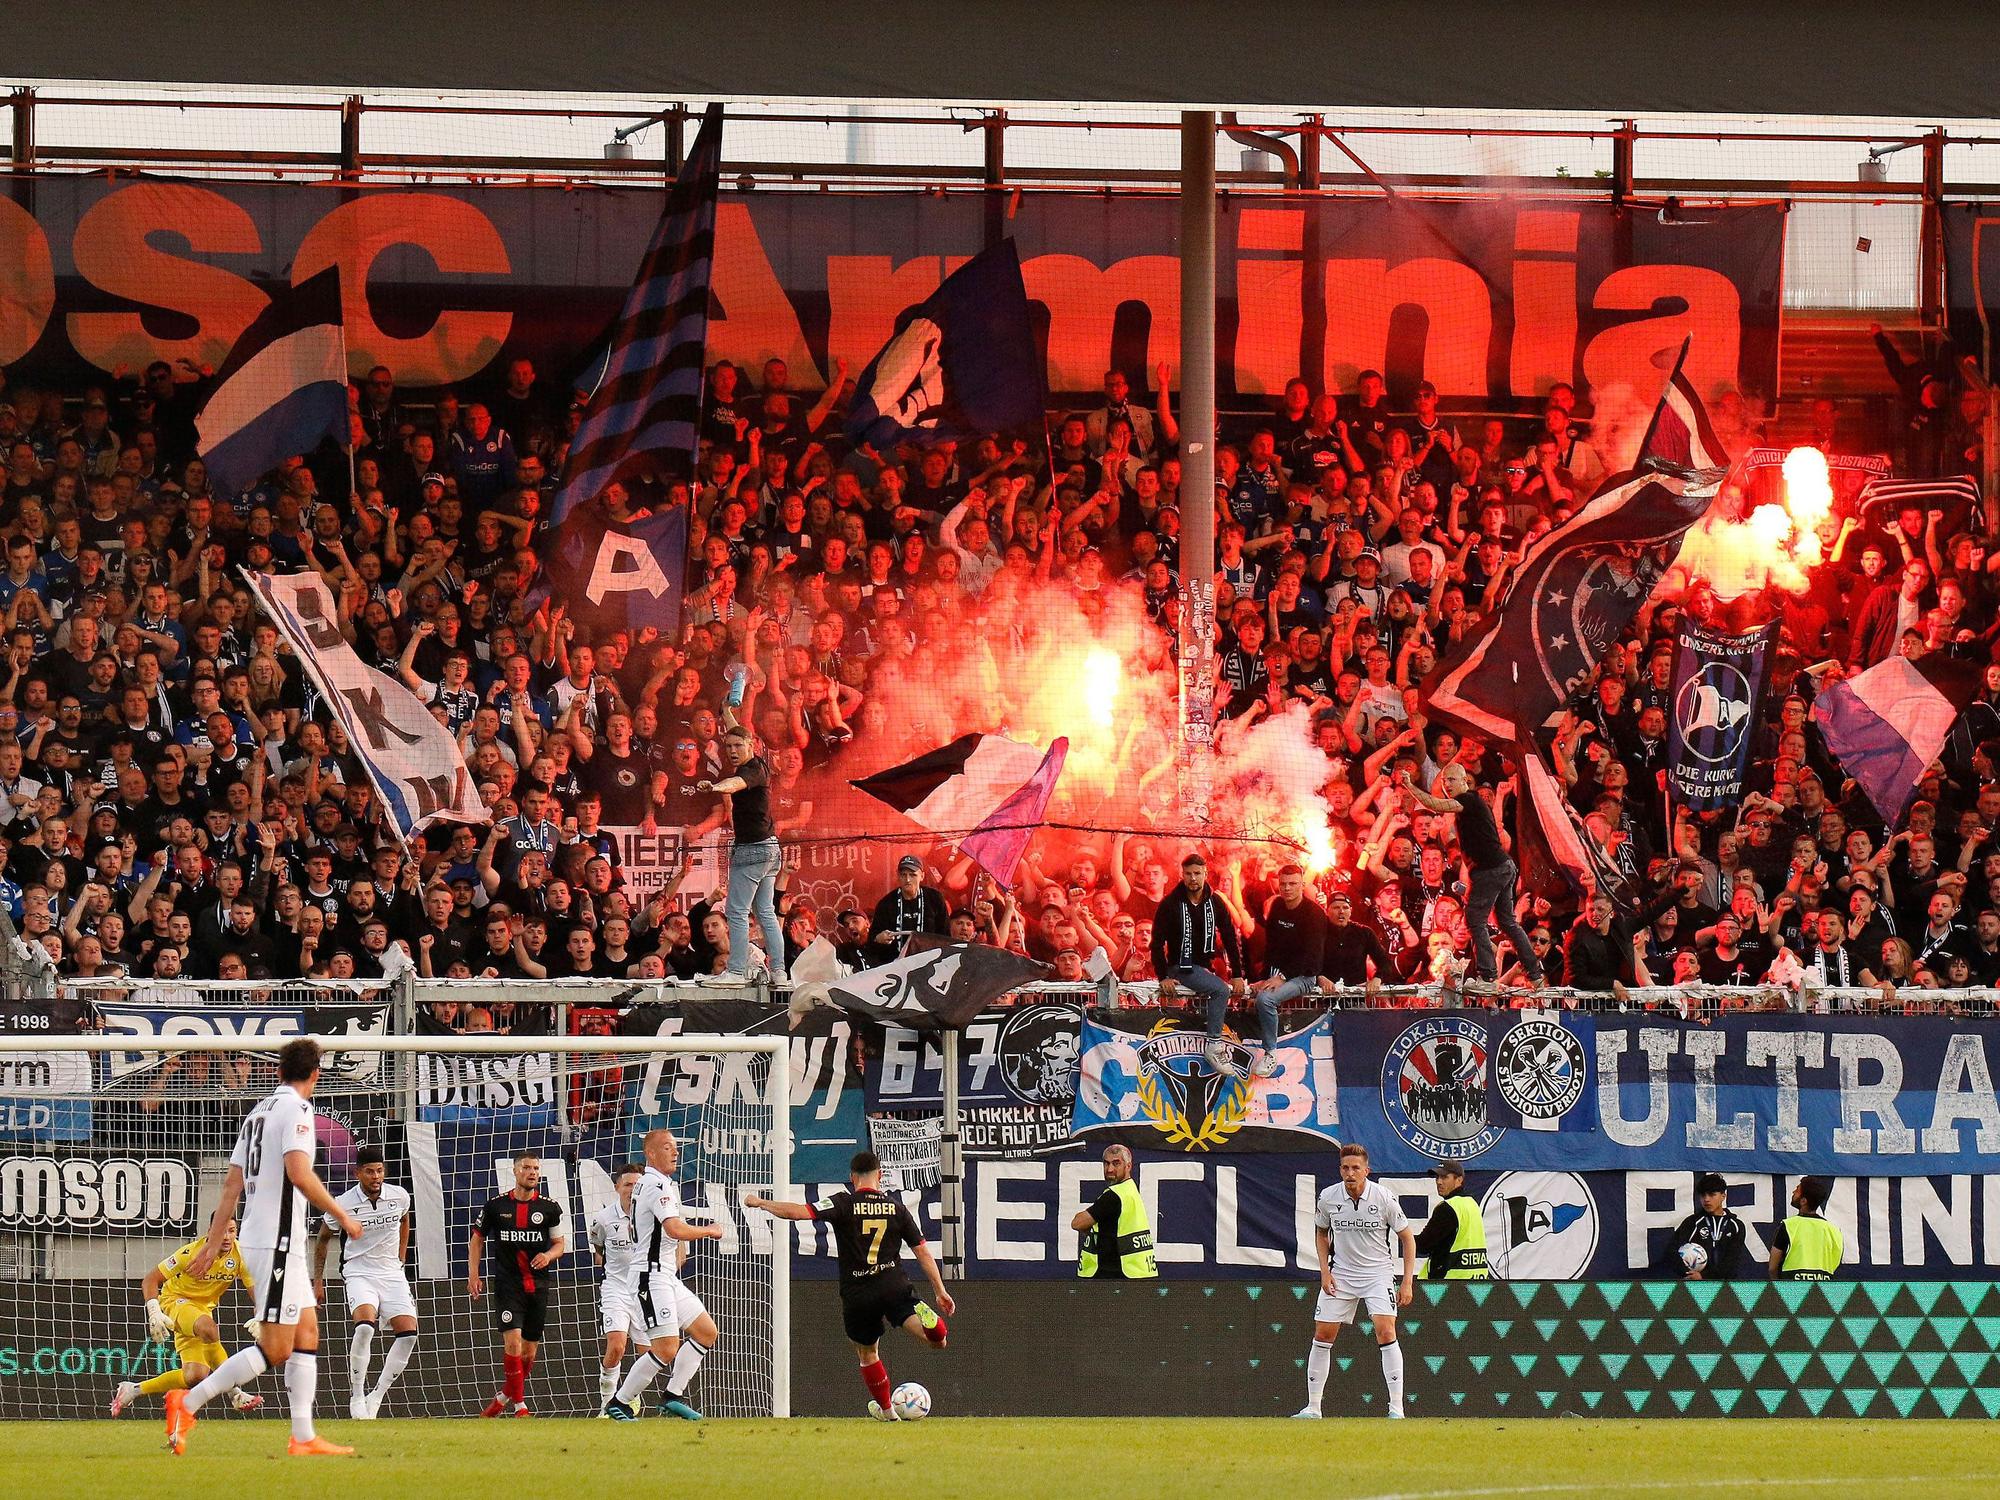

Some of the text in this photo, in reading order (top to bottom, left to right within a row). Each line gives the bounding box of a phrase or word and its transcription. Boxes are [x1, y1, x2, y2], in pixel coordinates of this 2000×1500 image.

[0, 182, 1741, 399] SC Arminia
[586, 530, 670, 606] A
[1676, 763, 1700, 780] DIE
[11, 1015, 50, 1029] 1998
[1391, 1020, 1487, 1060] LOKAL CRE
[1509, 1023, 1577, 1052] SEKTION
[1497, 1065, 1585, 1118] STADIONVERBOT
[703, 1128, 796, 1155] ULTRAS
[1005, 1149, 1033, 1158] ULTRAS
[1411, 1130, 1494, 1158] BIELEFELD
[361, 1216, 400, 1228] CHÜCO
[510, 1230, 544, 1243] BRITA
[862, 1218, 888, 1265] 7
[1387, 1288, 1396, 1304] 5
